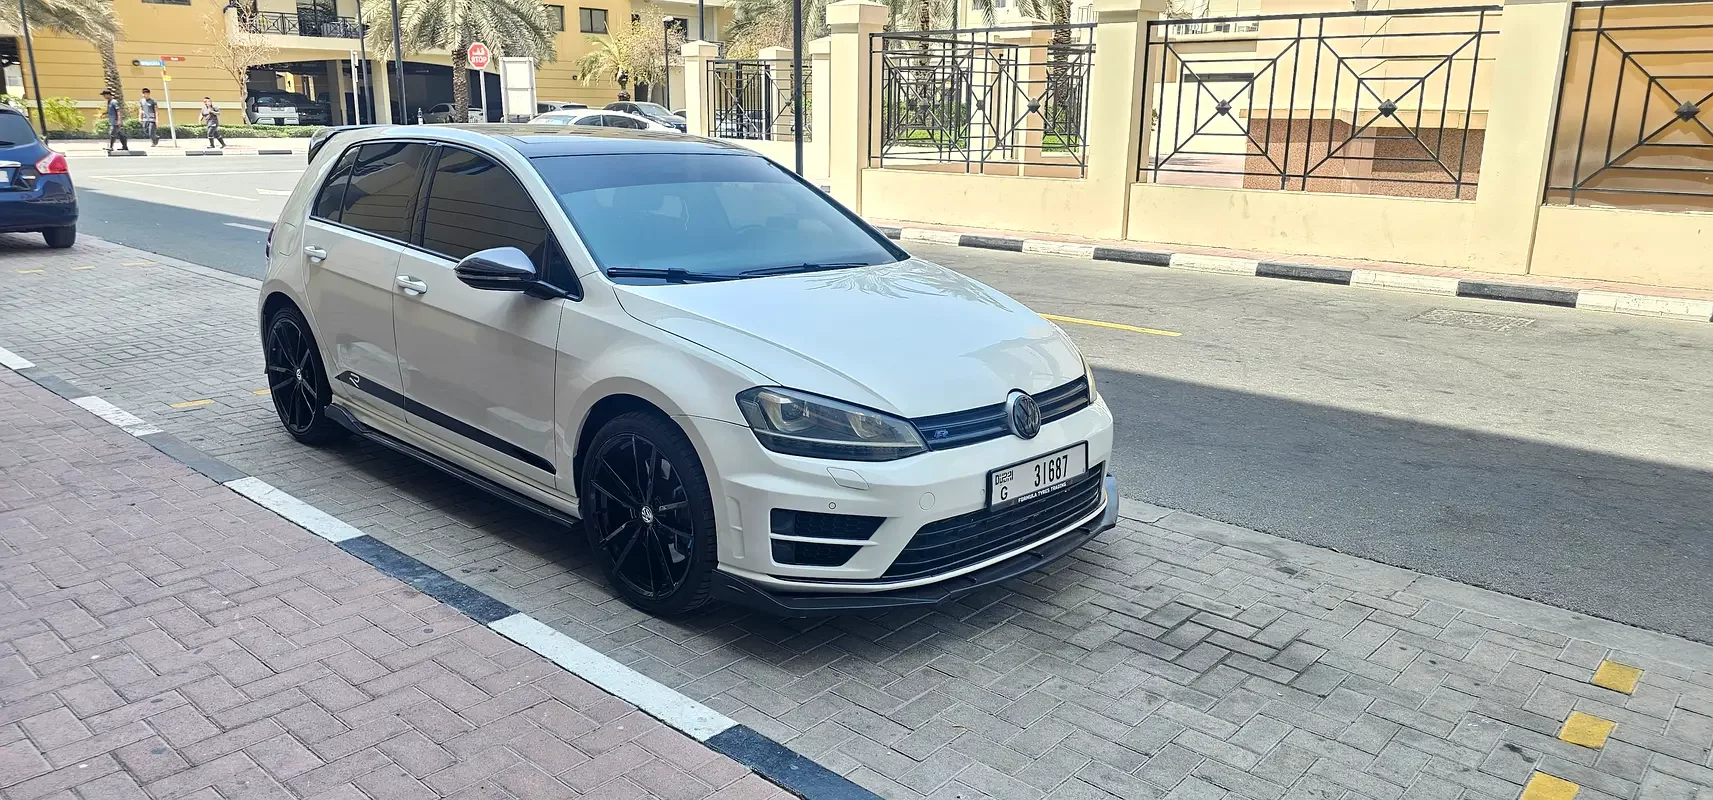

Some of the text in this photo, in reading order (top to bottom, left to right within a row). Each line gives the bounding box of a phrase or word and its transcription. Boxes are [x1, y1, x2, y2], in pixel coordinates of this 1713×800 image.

[1034, 455, 1068, 487] 31687
[1000, 486, 1008, 501] G
[1018, 482, 1067, 502] FORMULA TYRES TRADING
